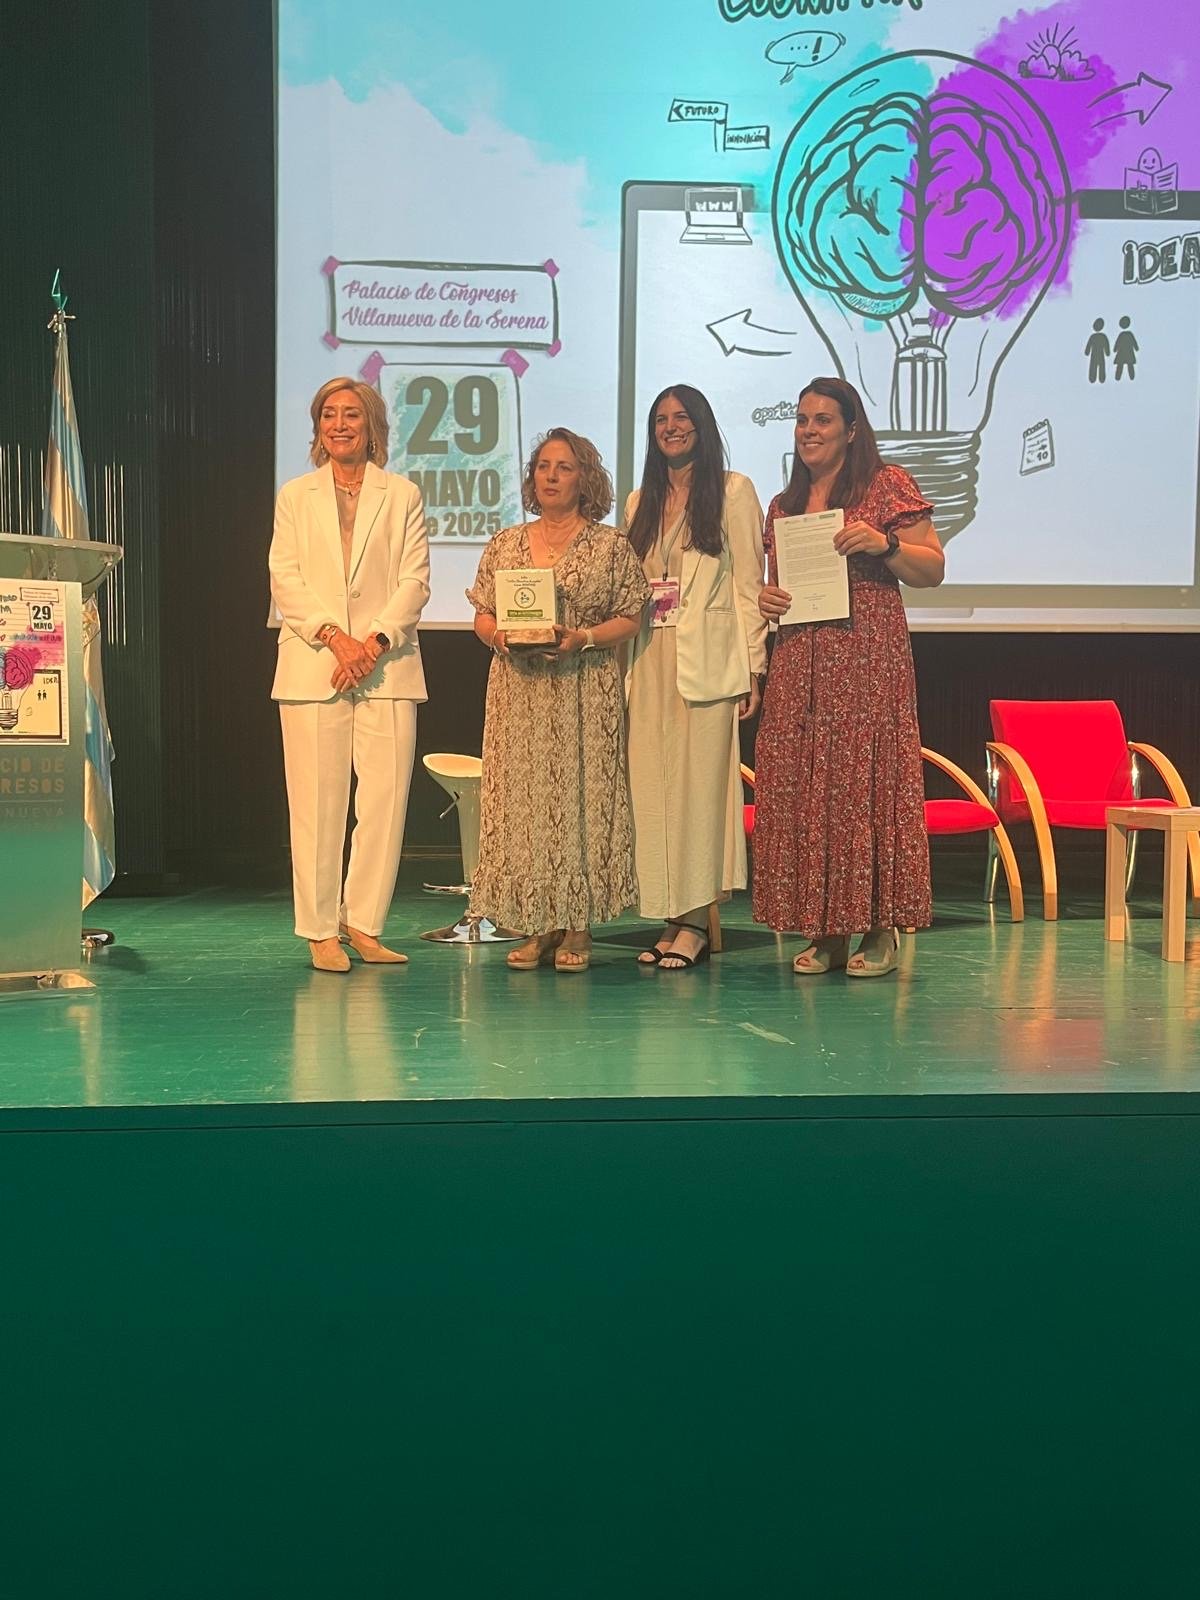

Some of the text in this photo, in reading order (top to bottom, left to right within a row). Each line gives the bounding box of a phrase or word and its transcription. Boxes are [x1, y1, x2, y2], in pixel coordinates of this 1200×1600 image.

[684, 105, 720, 117] FUTURO
[342, 279, 518, 306] Palacio de Congresos
[342, 306, 550, 330] Villanueva de la Serena
[405, 375, 499, 455] 29
[408, 468, 501, 507] MAYO
[443, 511, 501, 537] 2025
[32, 605, 52, 621] 29
[33, 622, 53, 630] MAYO
[41, 756, 65, 774] DE
